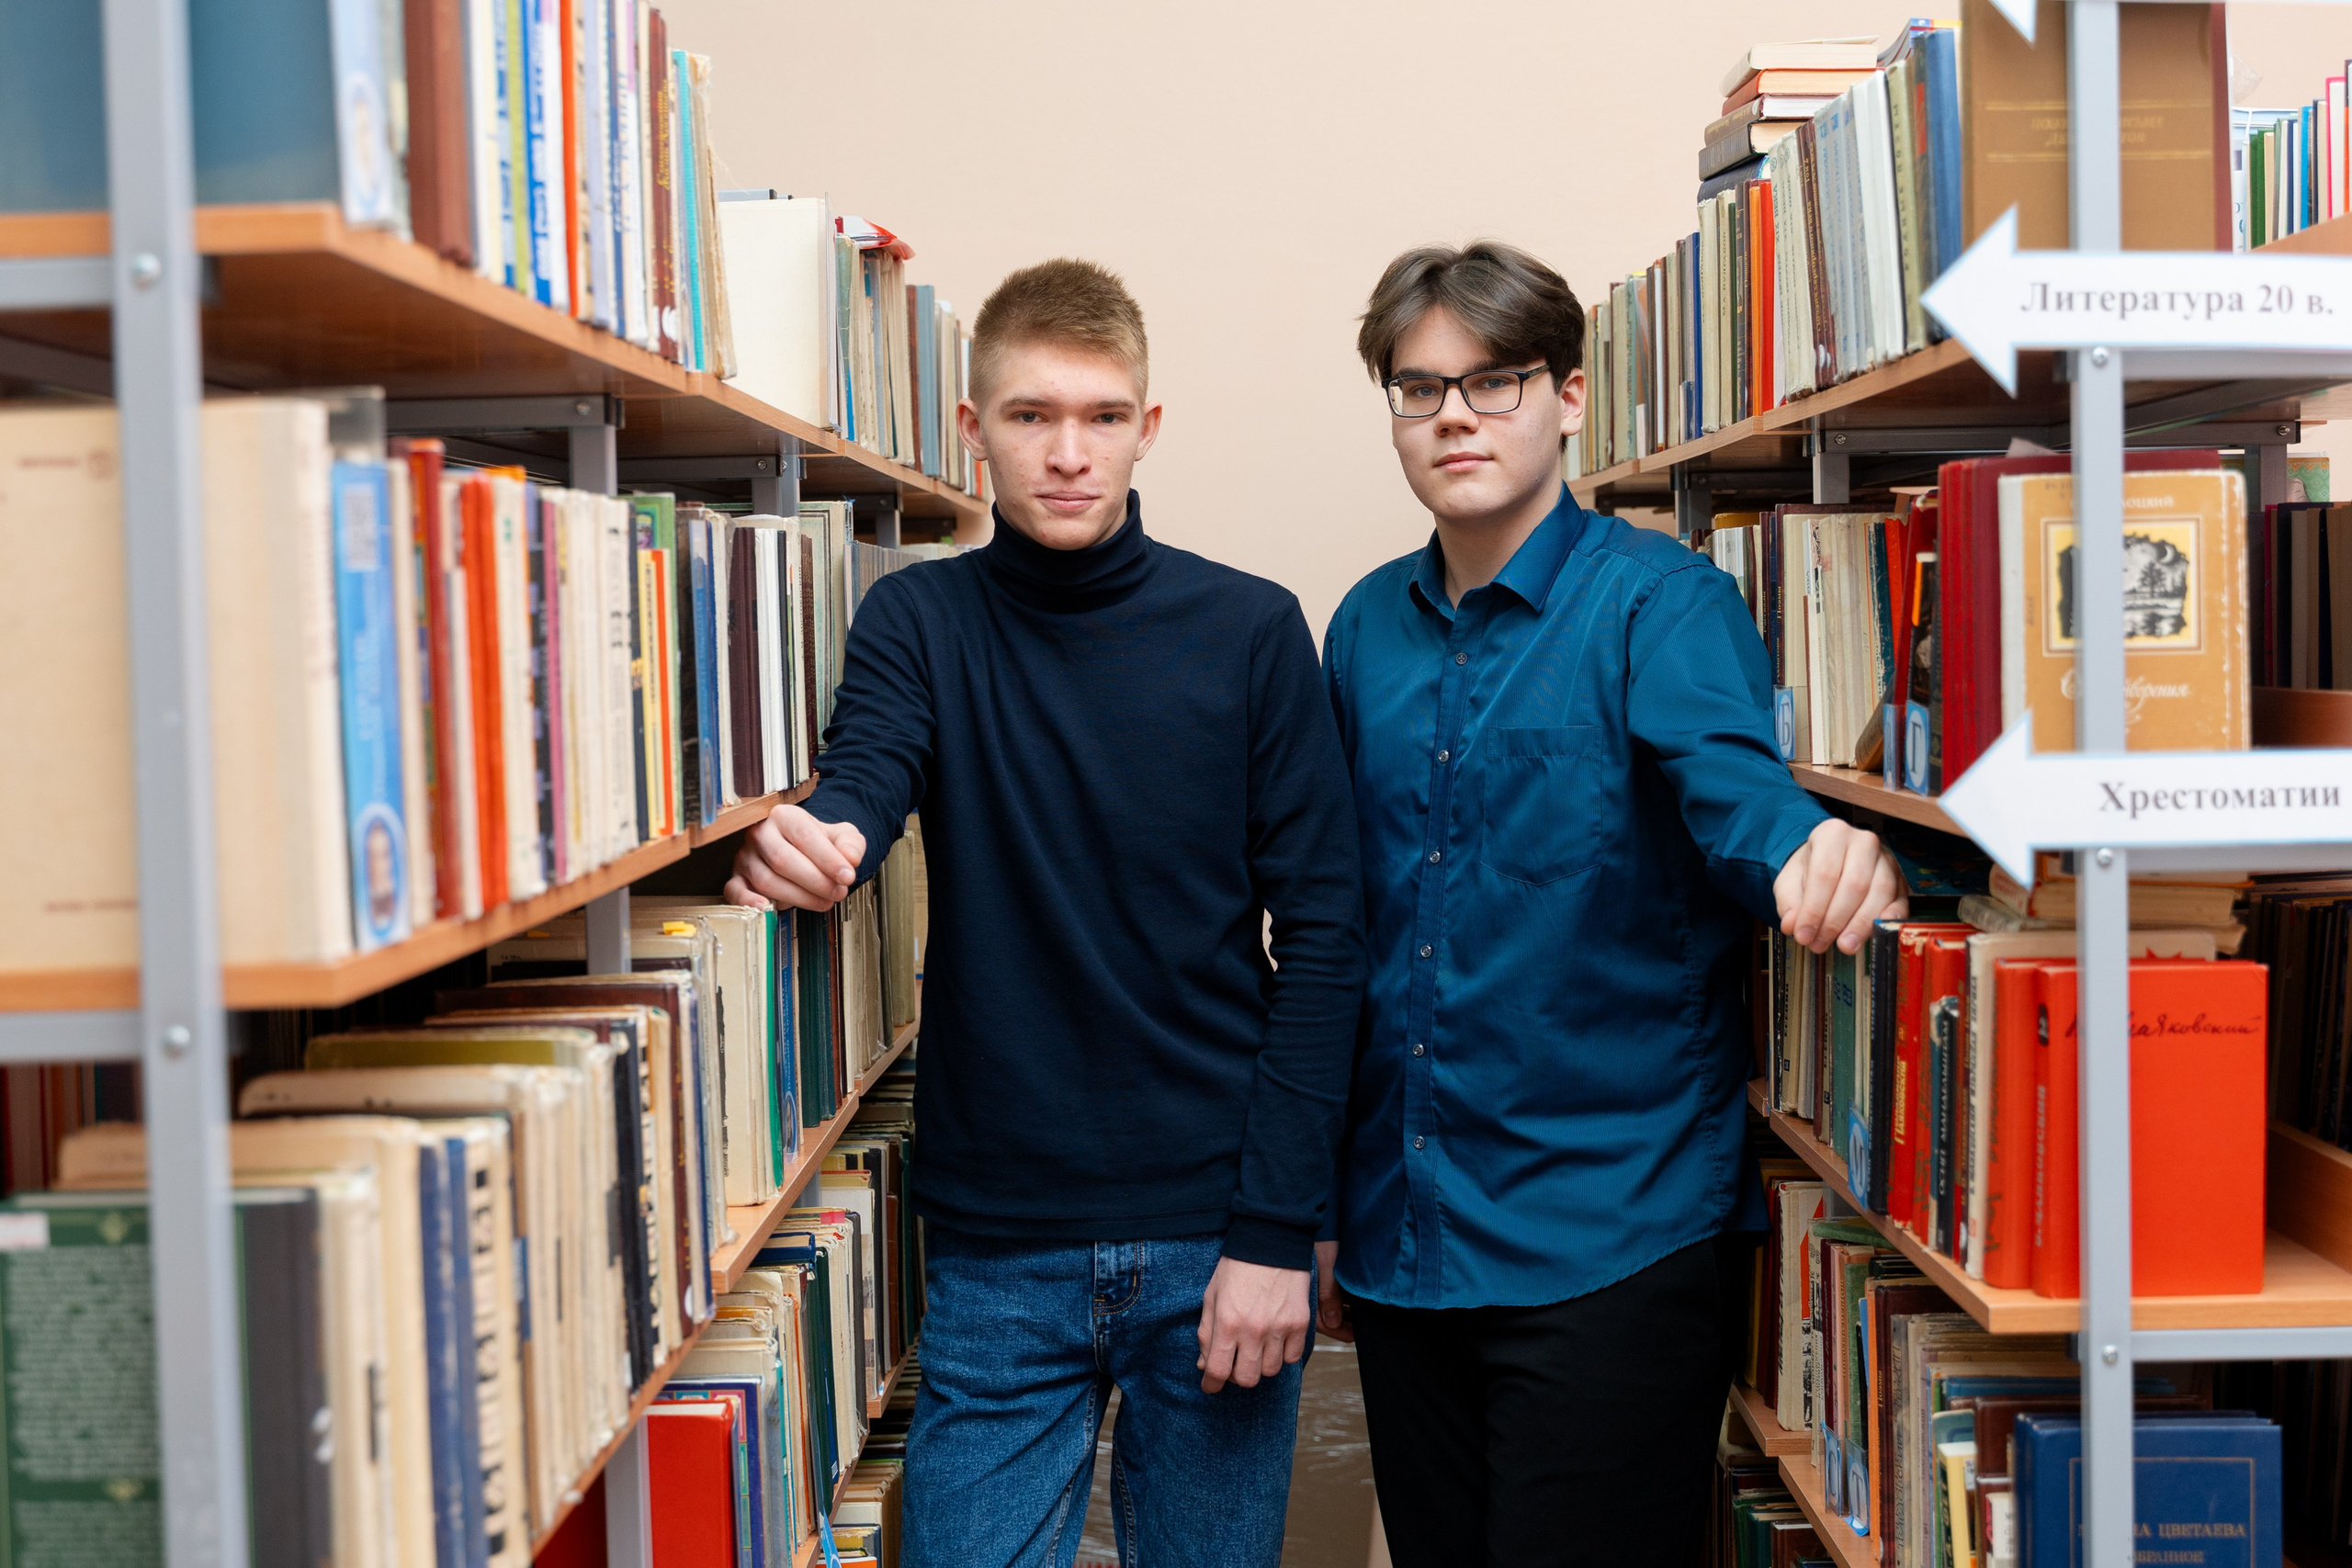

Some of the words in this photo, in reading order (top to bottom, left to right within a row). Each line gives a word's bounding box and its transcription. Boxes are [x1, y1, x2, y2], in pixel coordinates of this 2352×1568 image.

[2020, 282, 2245, 321] Литература
[2257, 284, 2294, 314] 20
[2306, 290, 2335, 316] в.
[1780, 701, 1792, 748] Б
[1910, 720, 1923, 775] Г
[2098, 781, 2341, 819] Хрестоматии
[1939, 1019, 1951, 1143] МАНДЕЛЬШТАМ
[1849, 1140, 1864, 1188] М
[1938, 1148, 1948, 1195] ОСИП
[1828, 1450, 1837, 1496] С
[1851, 1471, 1864, 1521] Т
[2158, 1522, 2246, 1540] ЦВЕТАЕВА
